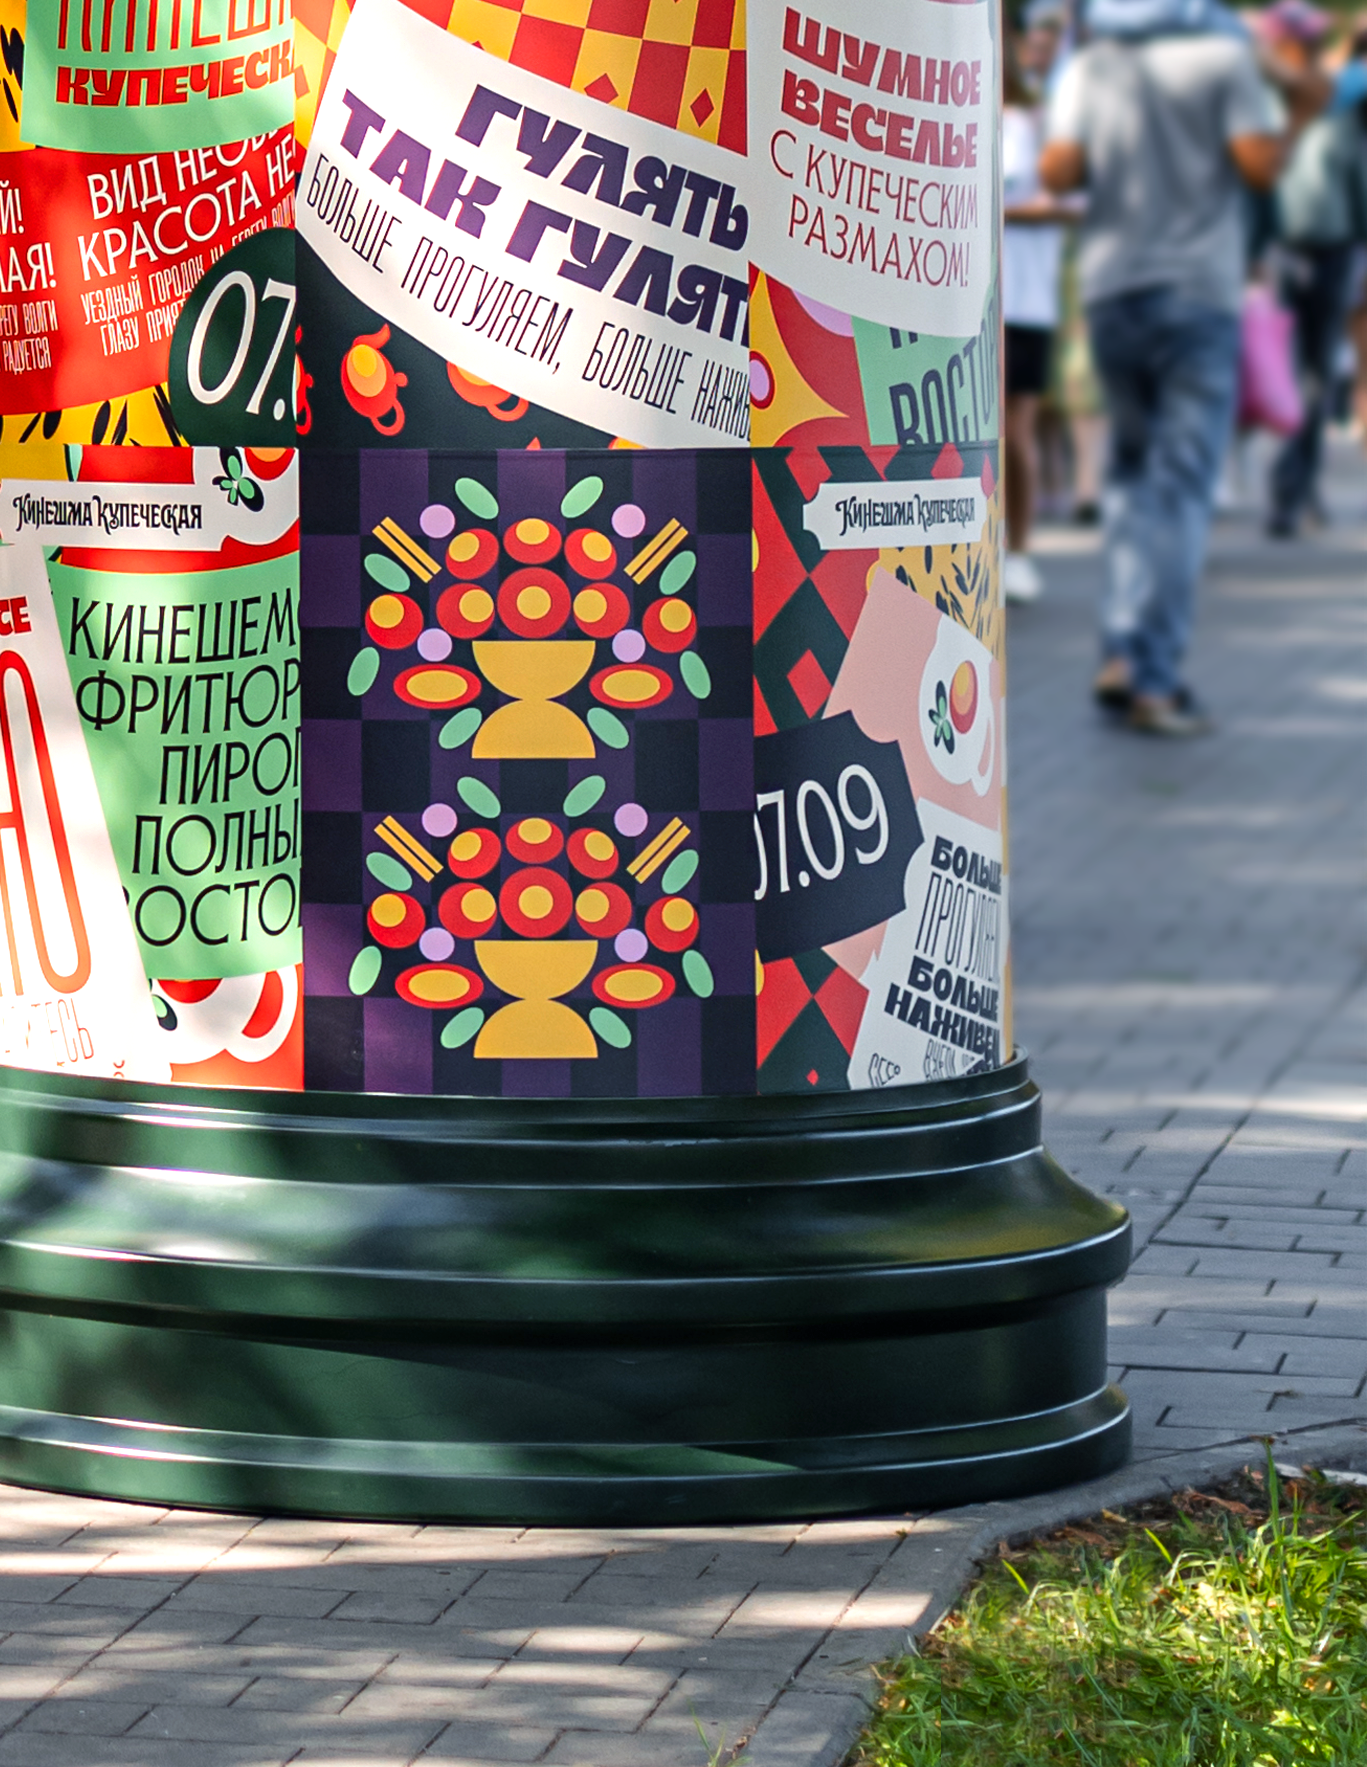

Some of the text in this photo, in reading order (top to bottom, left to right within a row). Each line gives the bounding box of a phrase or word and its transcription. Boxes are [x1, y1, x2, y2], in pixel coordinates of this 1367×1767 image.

[56, 39, 294, 108] КУПЕЧЕСК
[782, 5, 981, 108] ШУМНОЕ
[779, 68, 978, 170] ВЕСЕЛЬЕ
[87, 155, 167, 220] ВИД
[339, 88, 502, 240] ТАК
[454, 83, 750, 252] ГУЛЯТЬ
[769, 129, 979, 231] С КУПЕЧЕСКИМ
[77, 133, 296, 281] КРАСОТА НЕ
[788, 194, 972, 290] РАЗМАХОМ!
[81, 275, 144, 325] УЕЗДНЫЙ
[148, 254, 205, 306] ГОРОДОК
[306, 152, 751, 442] БОЛЬШЕ ПРОГУЛЯЕМ, БОЛЬШЕ НАЖИВ
[100, 316, 140, 356] ГЛАЗУ
[186, 270, 297, 422] 07.
[12, 493, 202, 535] КИНЕШМА КУПЕЧЕСКАЯ
[835, 495, 914, 536] КИНЕШМА
[68, 588, 301, 665] КИНЕШЕМ
[75, 658, 301, 734] ФРИТЮР
[131, 798, 302, 876] ПОЛНЫ
[930, 834, 1002, 896] БОЛЬШЕ
[123, 868, 302, 948] ОСТО
[907, 954, 999, 1023] БОЛЬШЕ
